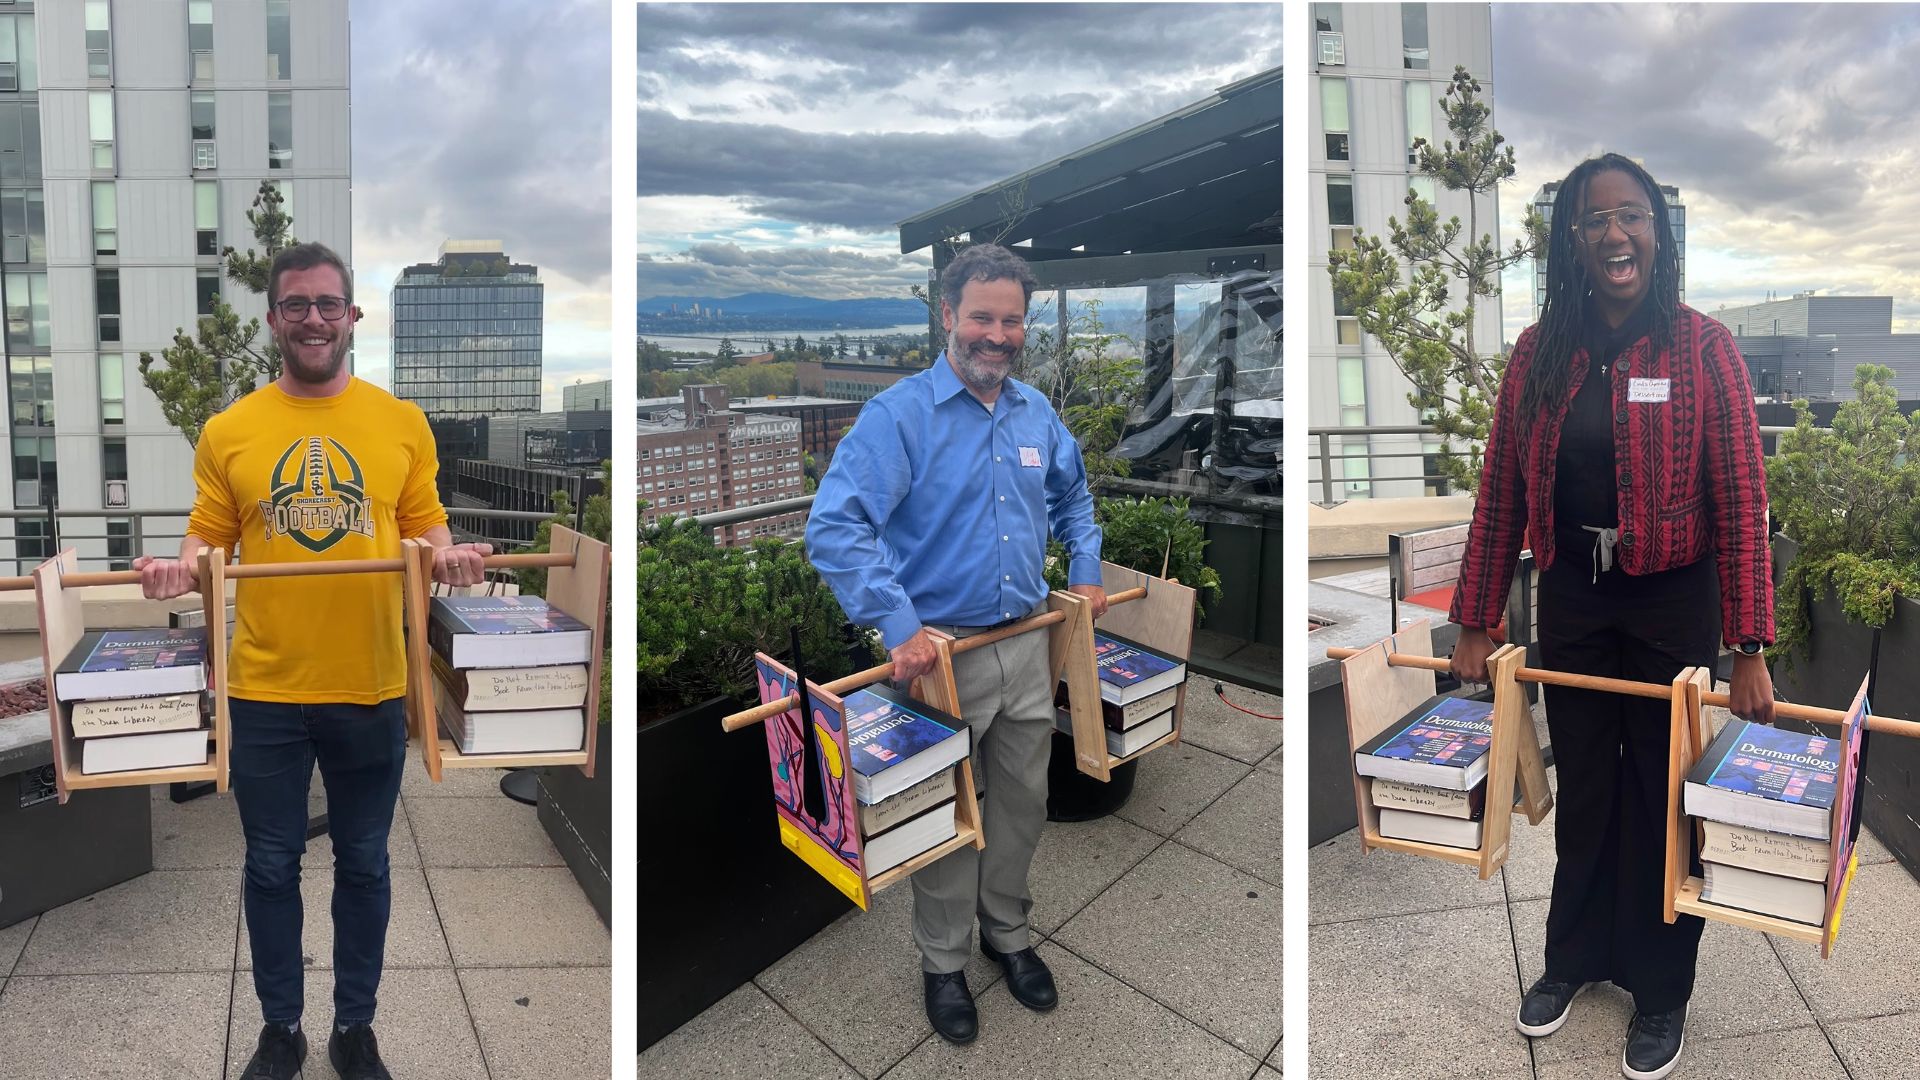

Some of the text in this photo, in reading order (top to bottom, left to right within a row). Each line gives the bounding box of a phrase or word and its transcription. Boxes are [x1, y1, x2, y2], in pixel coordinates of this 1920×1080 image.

[747, 421, 798, 437] MALLOY
[258, 497, 374, 541] FOOTBALL
[456, 605, 549, 613] Dermatology
[104, 637, 202, 648] Dermatology
[849, 714, 916, 748] Dermatolo
[1740, 743, 1839, 771] Dermatology
